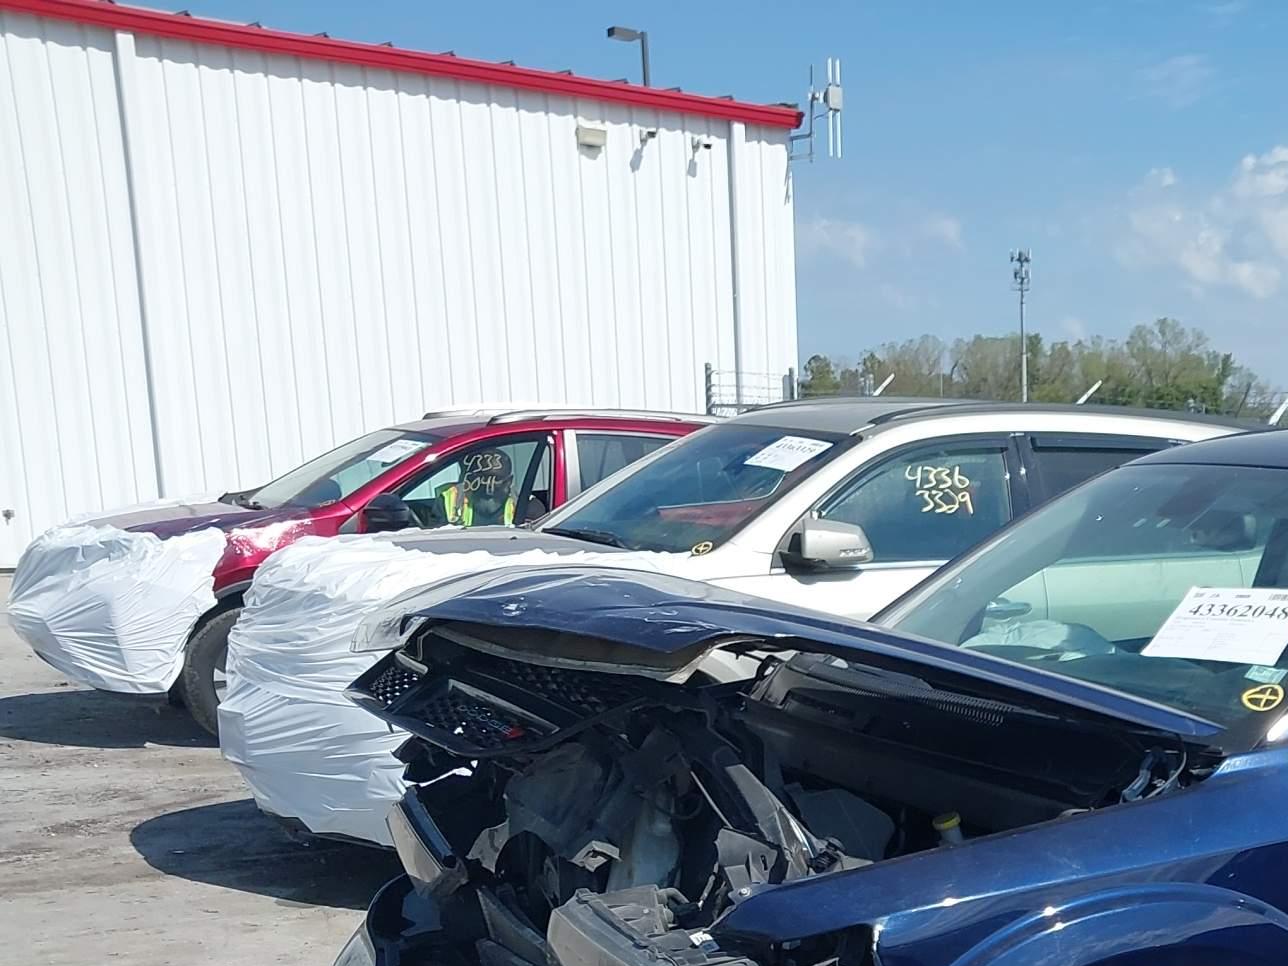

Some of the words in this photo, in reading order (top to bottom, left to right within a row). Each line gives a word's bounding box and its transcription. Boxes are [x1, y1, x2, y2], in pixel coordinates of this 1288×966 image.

[463, 454, 503, 473] 4333
[904, 465, 970, 489] 4336
[915, 488, 974, 515] 3329
